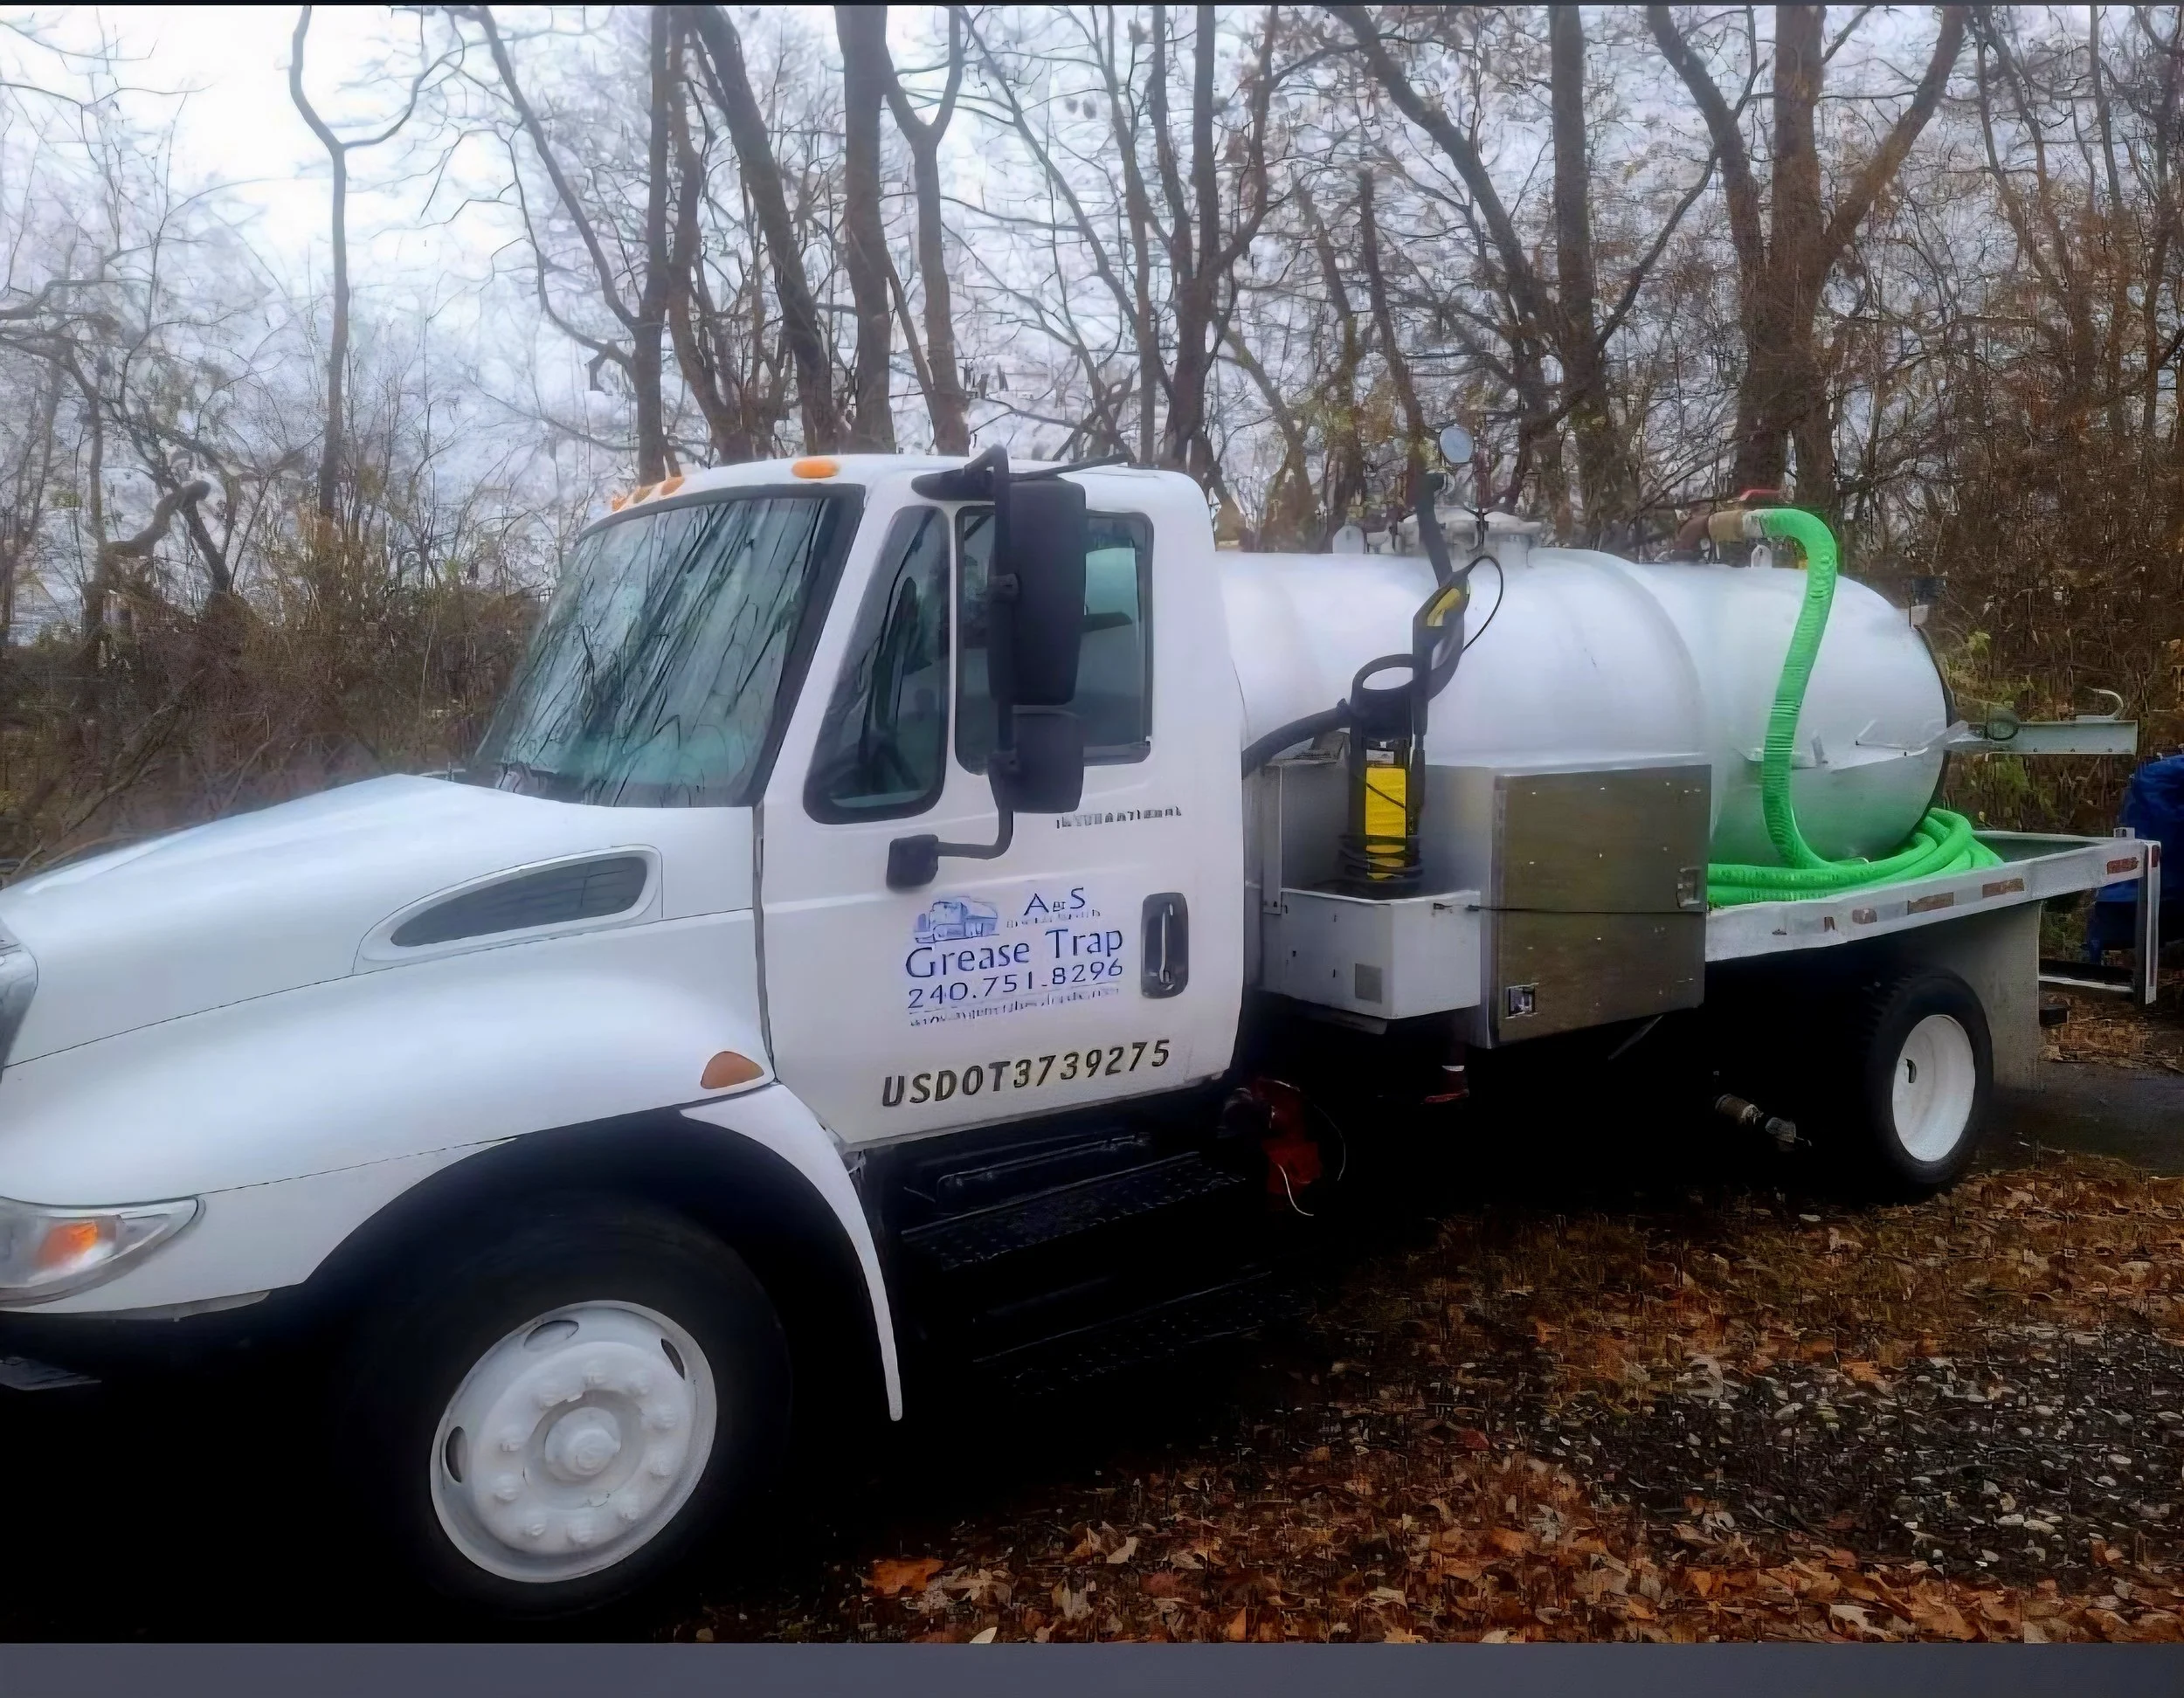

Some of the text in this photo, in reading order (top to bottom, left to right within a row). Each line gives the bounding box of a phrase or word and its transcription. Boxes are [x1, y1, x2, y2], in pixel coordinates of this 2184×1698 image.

[905, 928, 1123, 978] Grease Trap
[882, 1039, 1170, 1107] USDOT3739275
